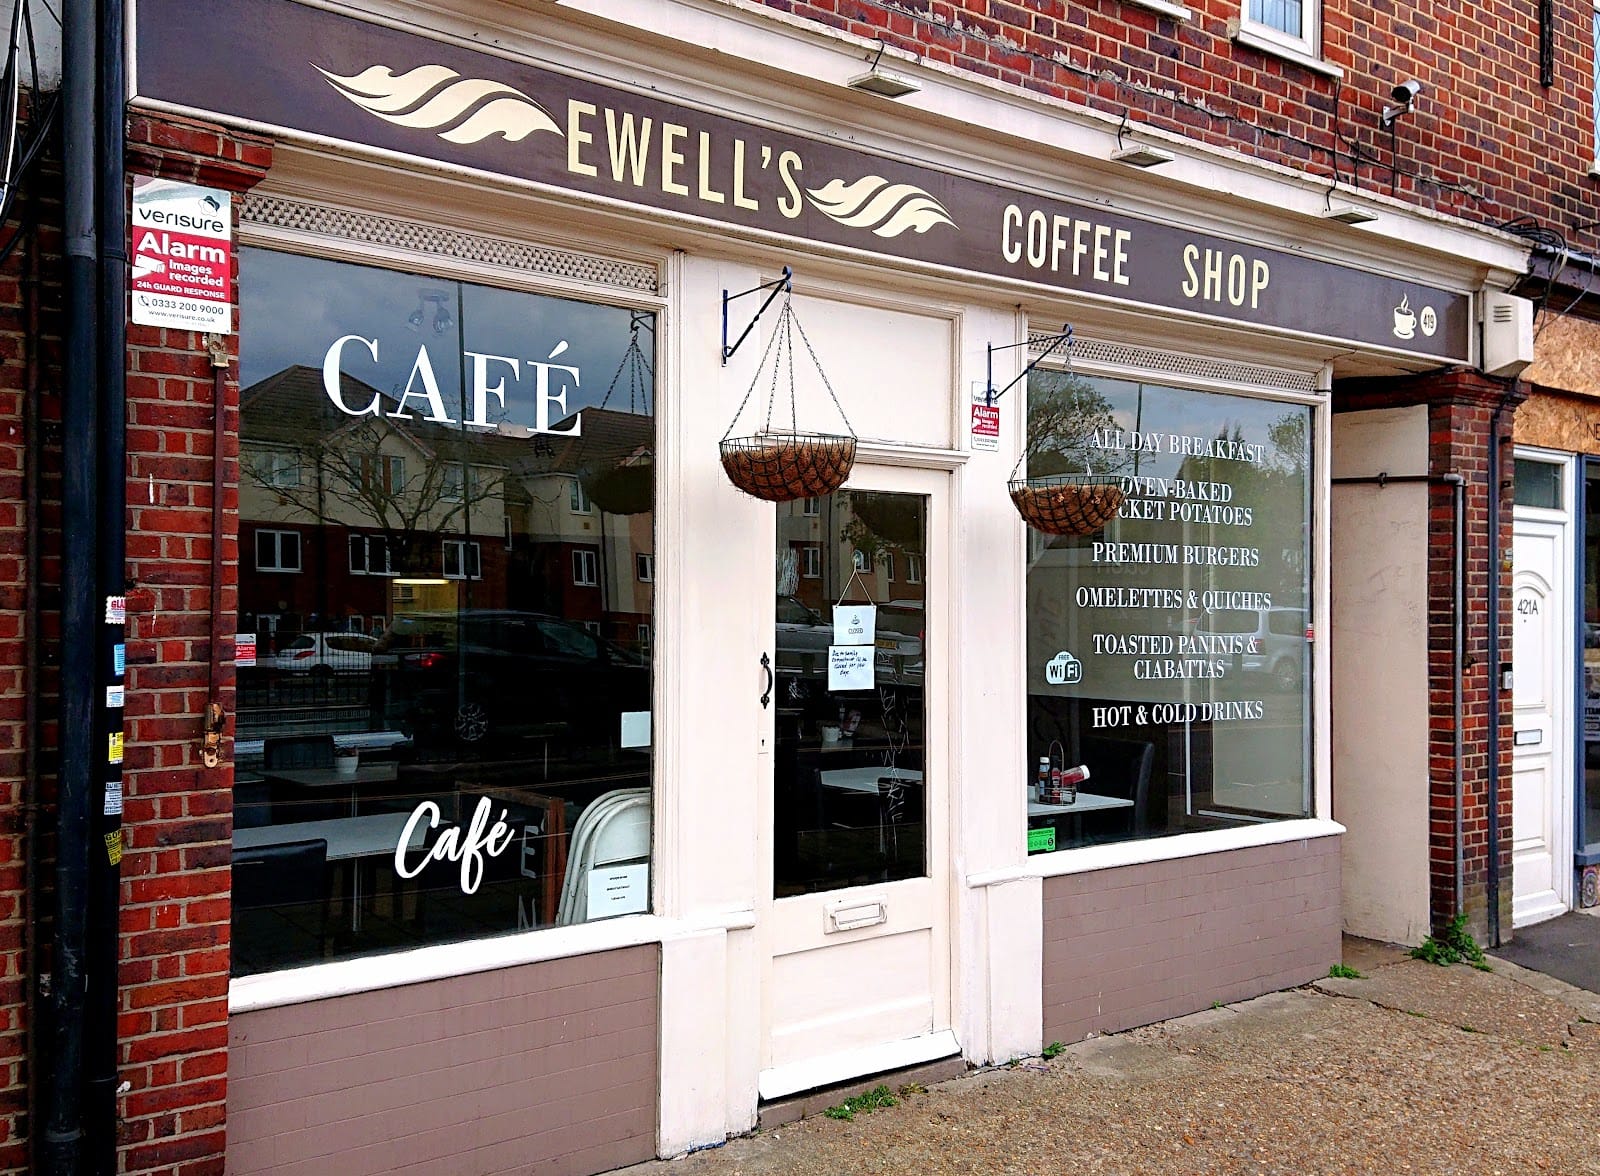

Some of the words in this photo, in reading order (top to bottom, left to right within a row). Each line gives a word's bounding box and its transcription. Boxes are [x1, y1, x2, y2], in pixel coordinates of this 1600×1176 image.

[567, 98, 803, 219] EWELL'S
[138, 207, 224, 233] verisure
[136, 231, 226, 264] Alarm
[1002, 204, 1132, 286] COFFEE
[1182, 243, 1270, 309] SHOP
[169, 259, 213, 275] Images
[169, 271, 224, 287] recorded
[136, 281, 152, 289] 24h
[153, 283, 182, 293] GUARD
[184, 287, 225, 299] RESPONSE
[148, 310, 216, 323] www.verisure.co.uk
[151, 298, 177, 309] 0333
[179, 302, 198, 312] 200
[200, 305, 224, 315] 9000
[1423, 313, 1434, 329] 419
[322, 334, 582, 437] CAFÉ
[973, 406, 999, 419] Alarm
[1090, 428, 1126, 451] ALL
[1130, 431, 1165, 453] DAY
[1168, 433, 1265, 463] BREAKFAST
[1121, 475, 1232, 503] OVEN-BAKED
[1115, 498, 1166, 521] CKET
[1169, 501, 1253, 527] POTATOES
[1092, 542, 1179, 565] PREMIUM
[1183, 545, 1259, 567] BURGERS
[1076, 586, 1183, 610] OMELETTES
[1186, 589, 1199, 610] &
[1202, 590, 1272, 615] QUICHES
[1517, 598, 1539, 615] 421A
[848, 627, 864, 635] CLOSED
[1093, 634, 1173, 655] TOASTED
[1177, 635, 1243, 655] PANINIS
[1246, 634, 1258, 654] &
[1133, 659, 1225, 680] CIABATTAS
[1092, 705, 1132, 728] HOT
[1136, 704, 1149, 725] &
[1152, 702, 1197, 725] COLD
[1201, 700, 1264, 722] DRINKS
[394, 795, 516, 895] Café
